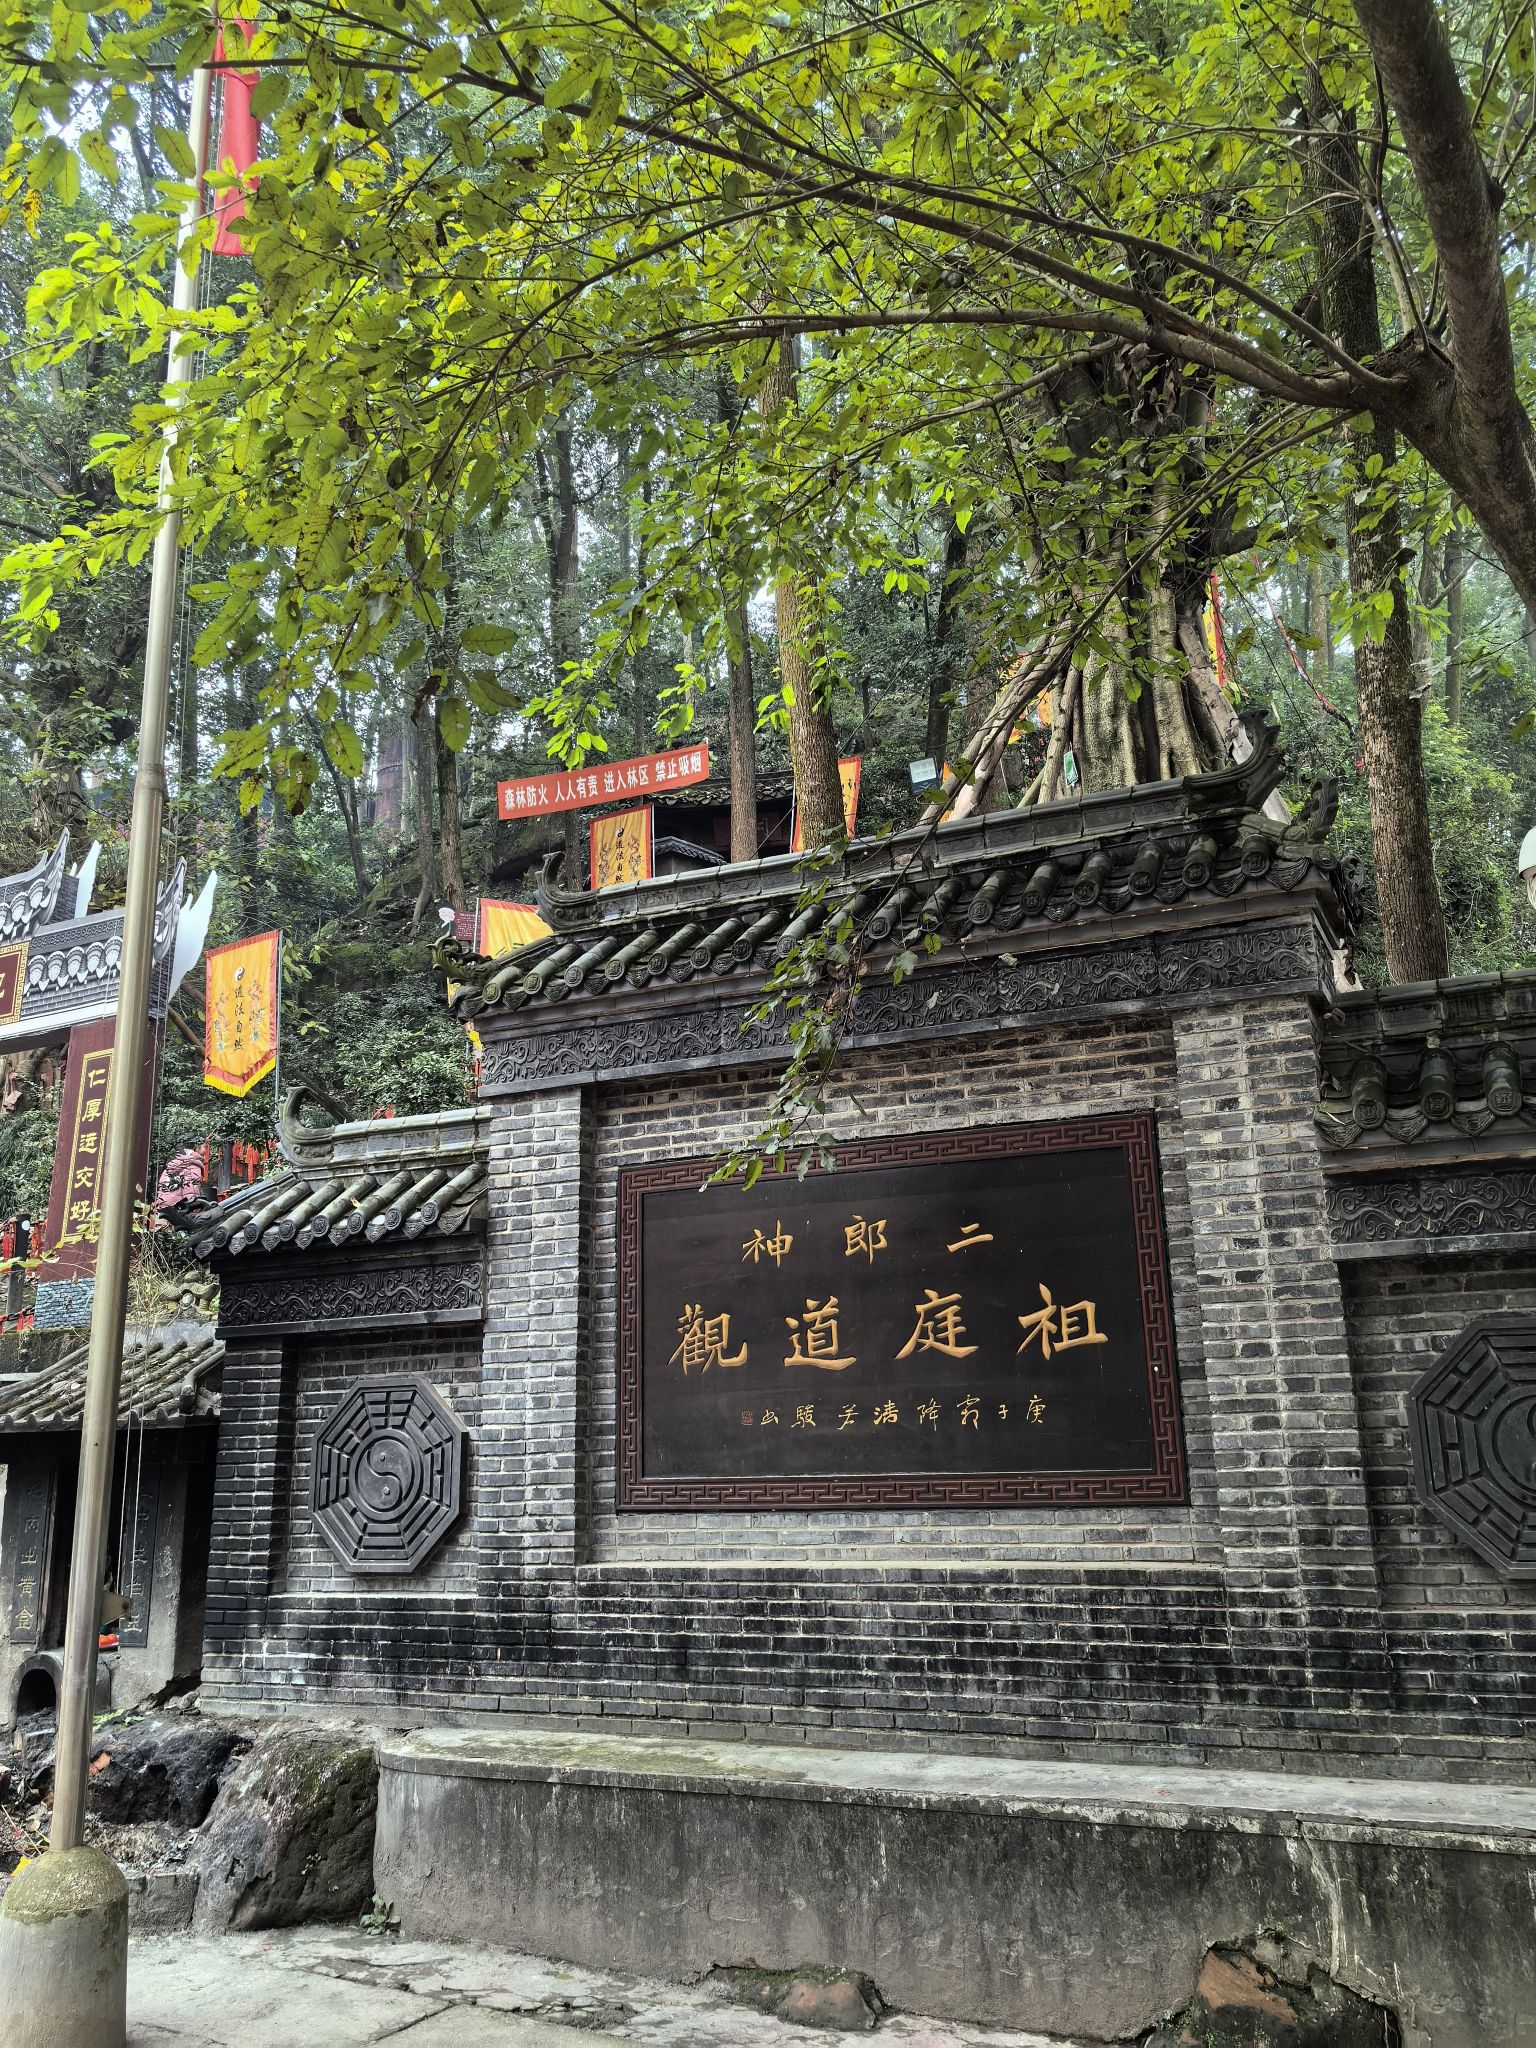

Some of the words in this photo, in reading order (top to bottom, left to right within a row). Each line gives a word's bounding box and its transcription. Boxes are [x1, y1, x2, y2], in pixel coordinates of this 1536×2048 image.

[504, 782, 549, 810] 森林防火
[554, 774, 598, 802] 人人有责
[603, 764, 649, 793] 进入林区
[655, 751, 702, 781] 禁止吸烟
[233, 984, 245, 1052] 道法自然
[69, 1068, 107, 1223] 仁厚运交好
[741, 1214, 994, 1268] 二郎神
[668, 1283, 1109, 1376] 祖庭道觀
